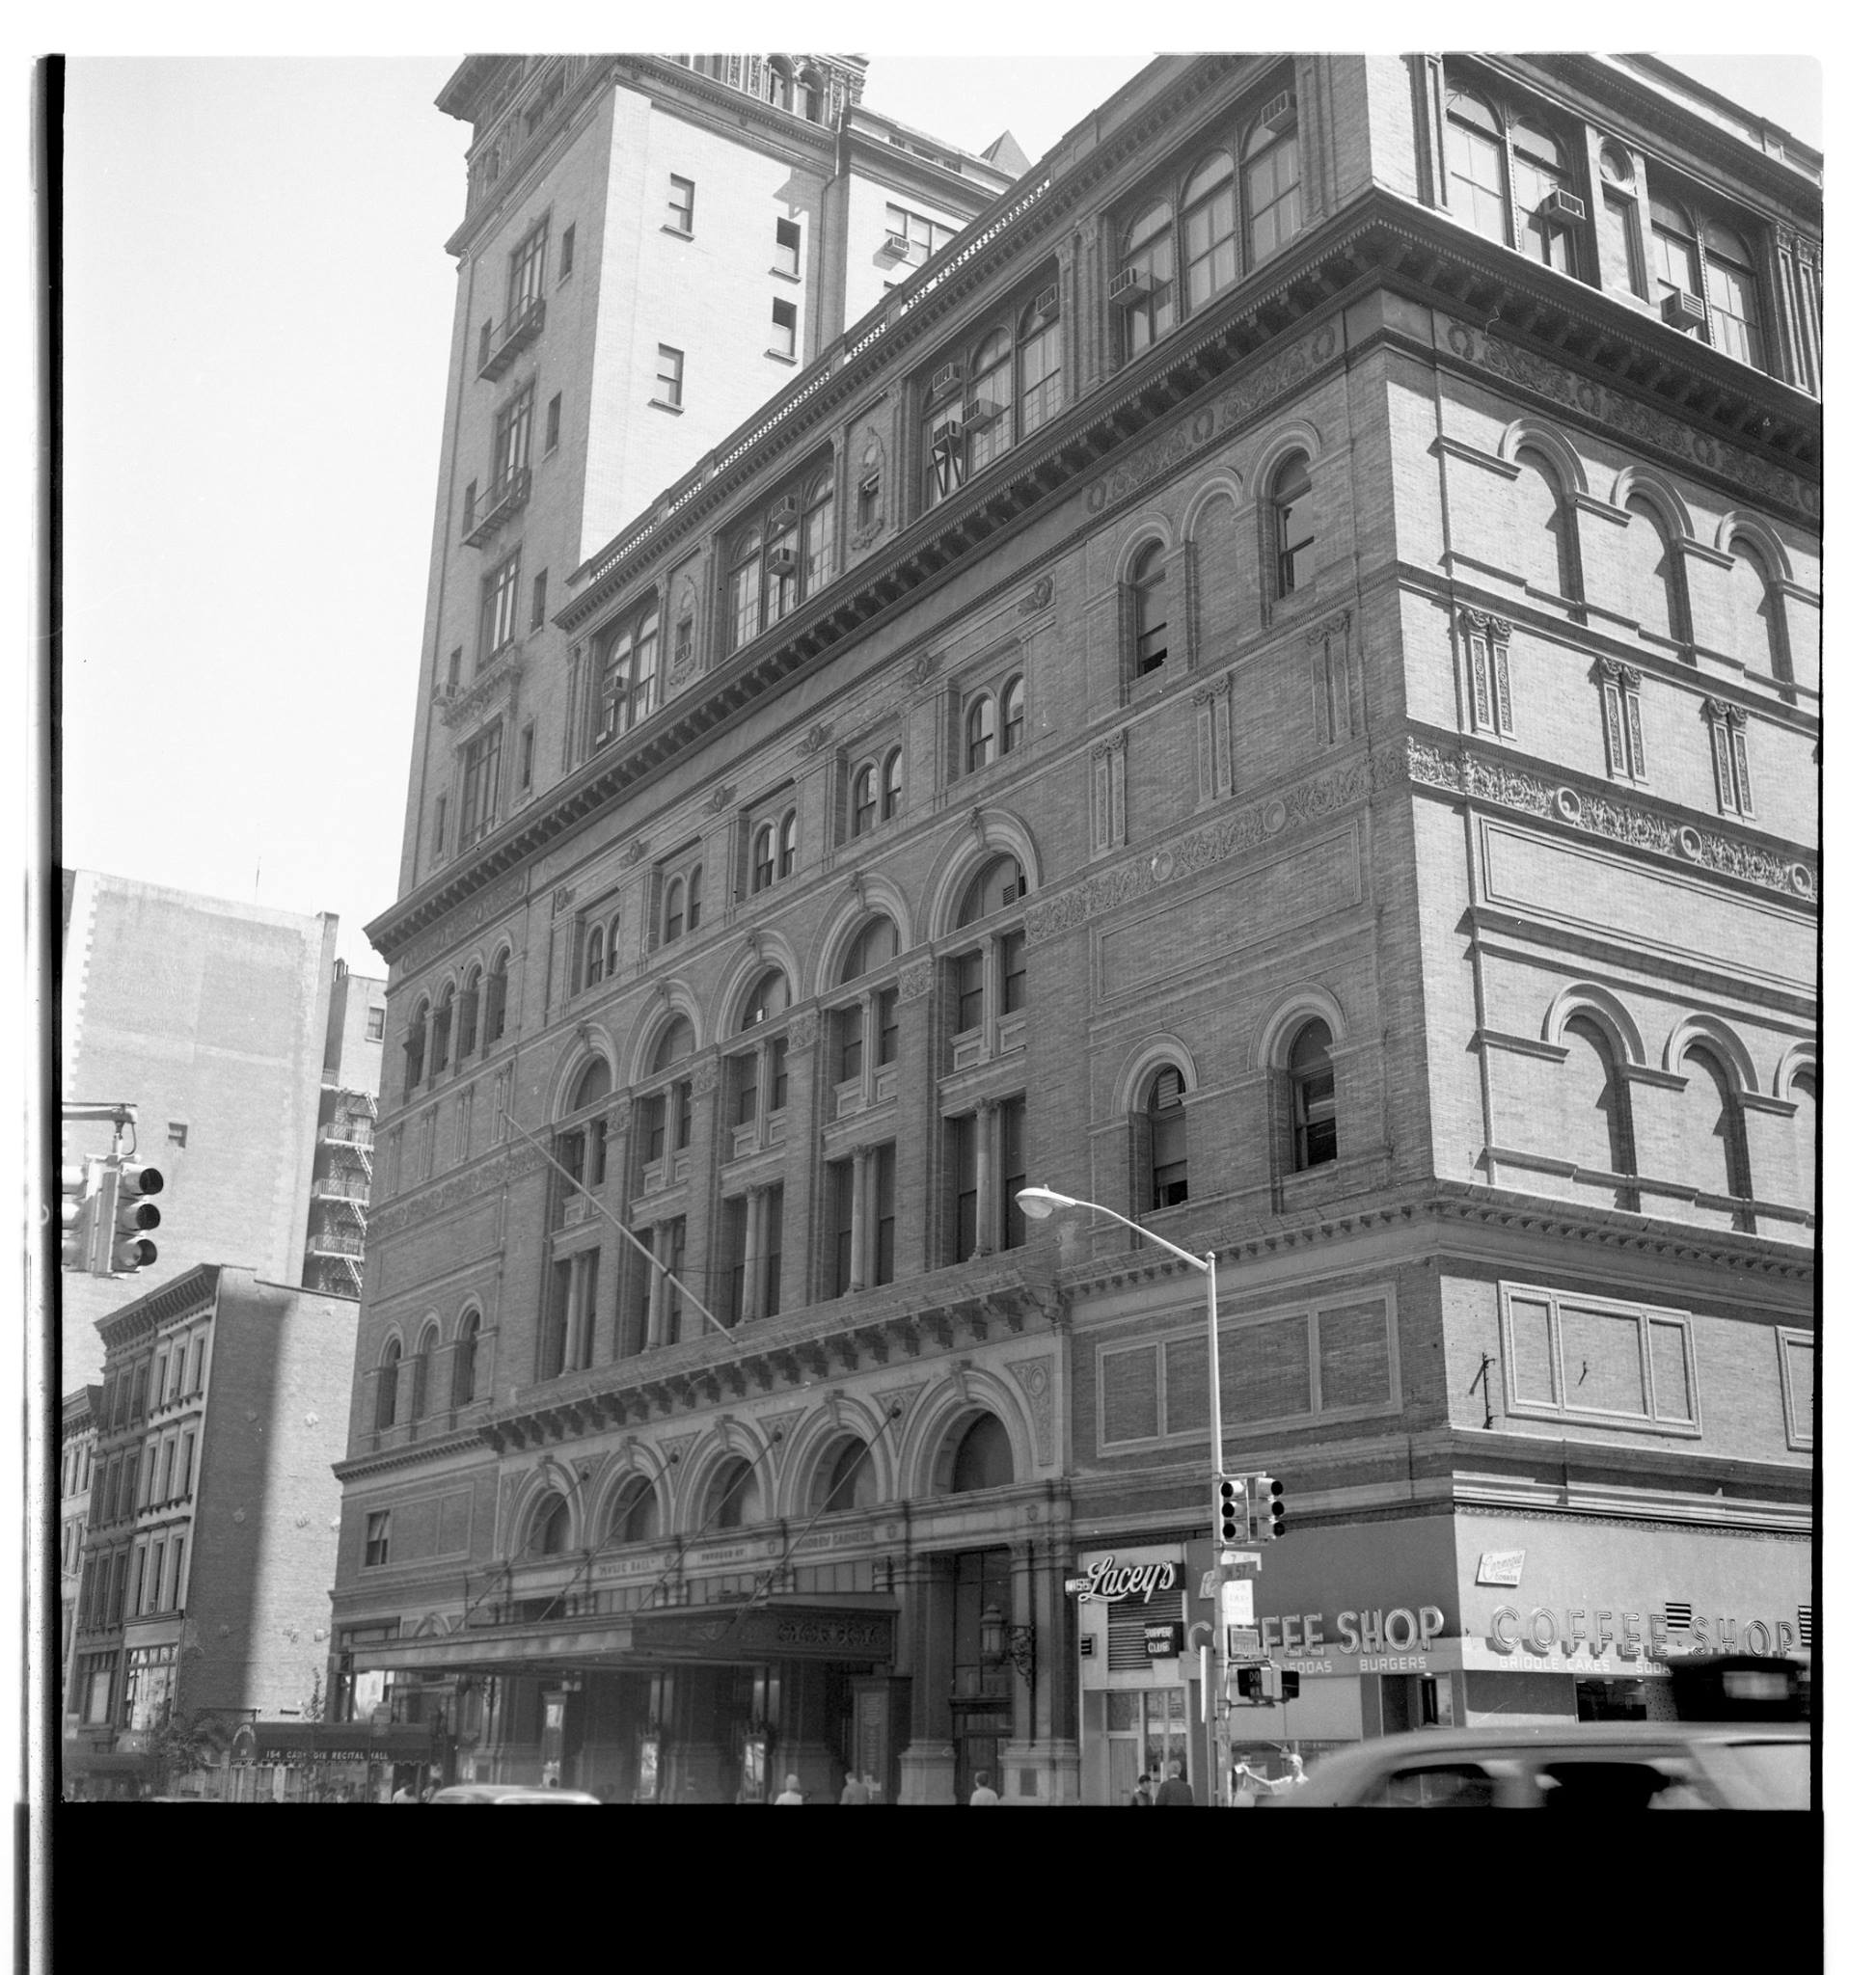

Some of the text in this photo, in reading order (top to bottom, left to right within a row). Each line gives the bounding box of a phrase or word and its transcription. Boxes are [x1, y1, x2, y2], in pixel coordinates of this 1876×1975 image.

[1078, 1555, 1176, 1604] Lacey's
[1186, 1604, 1445, 1660] CFEE SHOP
[1490, 1606, 1794, 1659] COFFEE SHOP
[1359, 1657, 1427, 1672] BURGERS
[1499, 1655, 1560, 1671] GRIDDLE
[1566, 1657, 1611, 1673] CAKES
